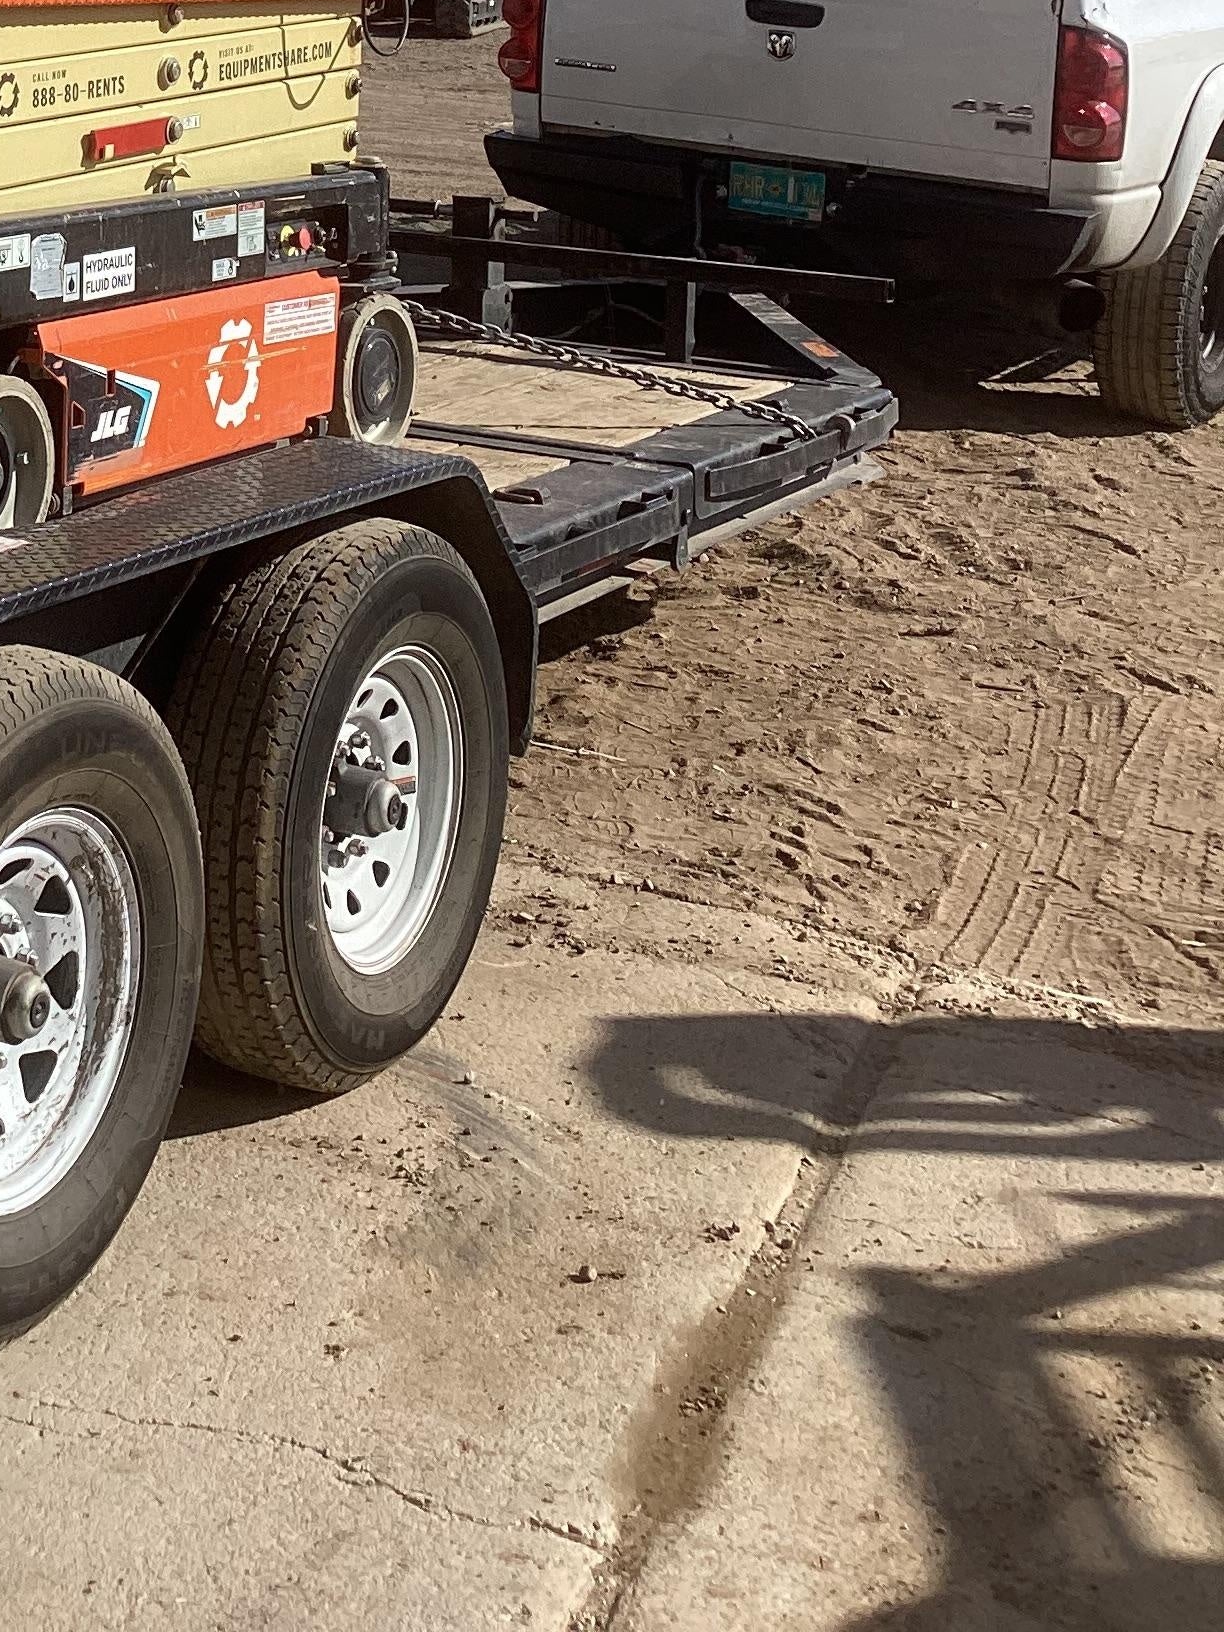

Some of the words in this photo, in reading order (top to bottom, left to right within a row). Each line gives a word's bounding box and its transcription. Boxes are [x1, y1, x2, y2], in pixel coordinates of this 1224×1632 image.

[219, 47, 234, 59] VISIT
[236, 45, 243, 56] US
[219, 41, 332, 82] EQUIPMENTSHARE.COM
[32, 72, 50, 83] CALL
[52, 69, 67, 80] NOW
[32, 75, 125, 108] 888-80-RENTS
[85, 253, 133, 274] HYDRAULIC
[85, 277, 110, 294] FLUID
[111, 273, 133, 289] ONLY
[90, 405, 132, 442] JLG
